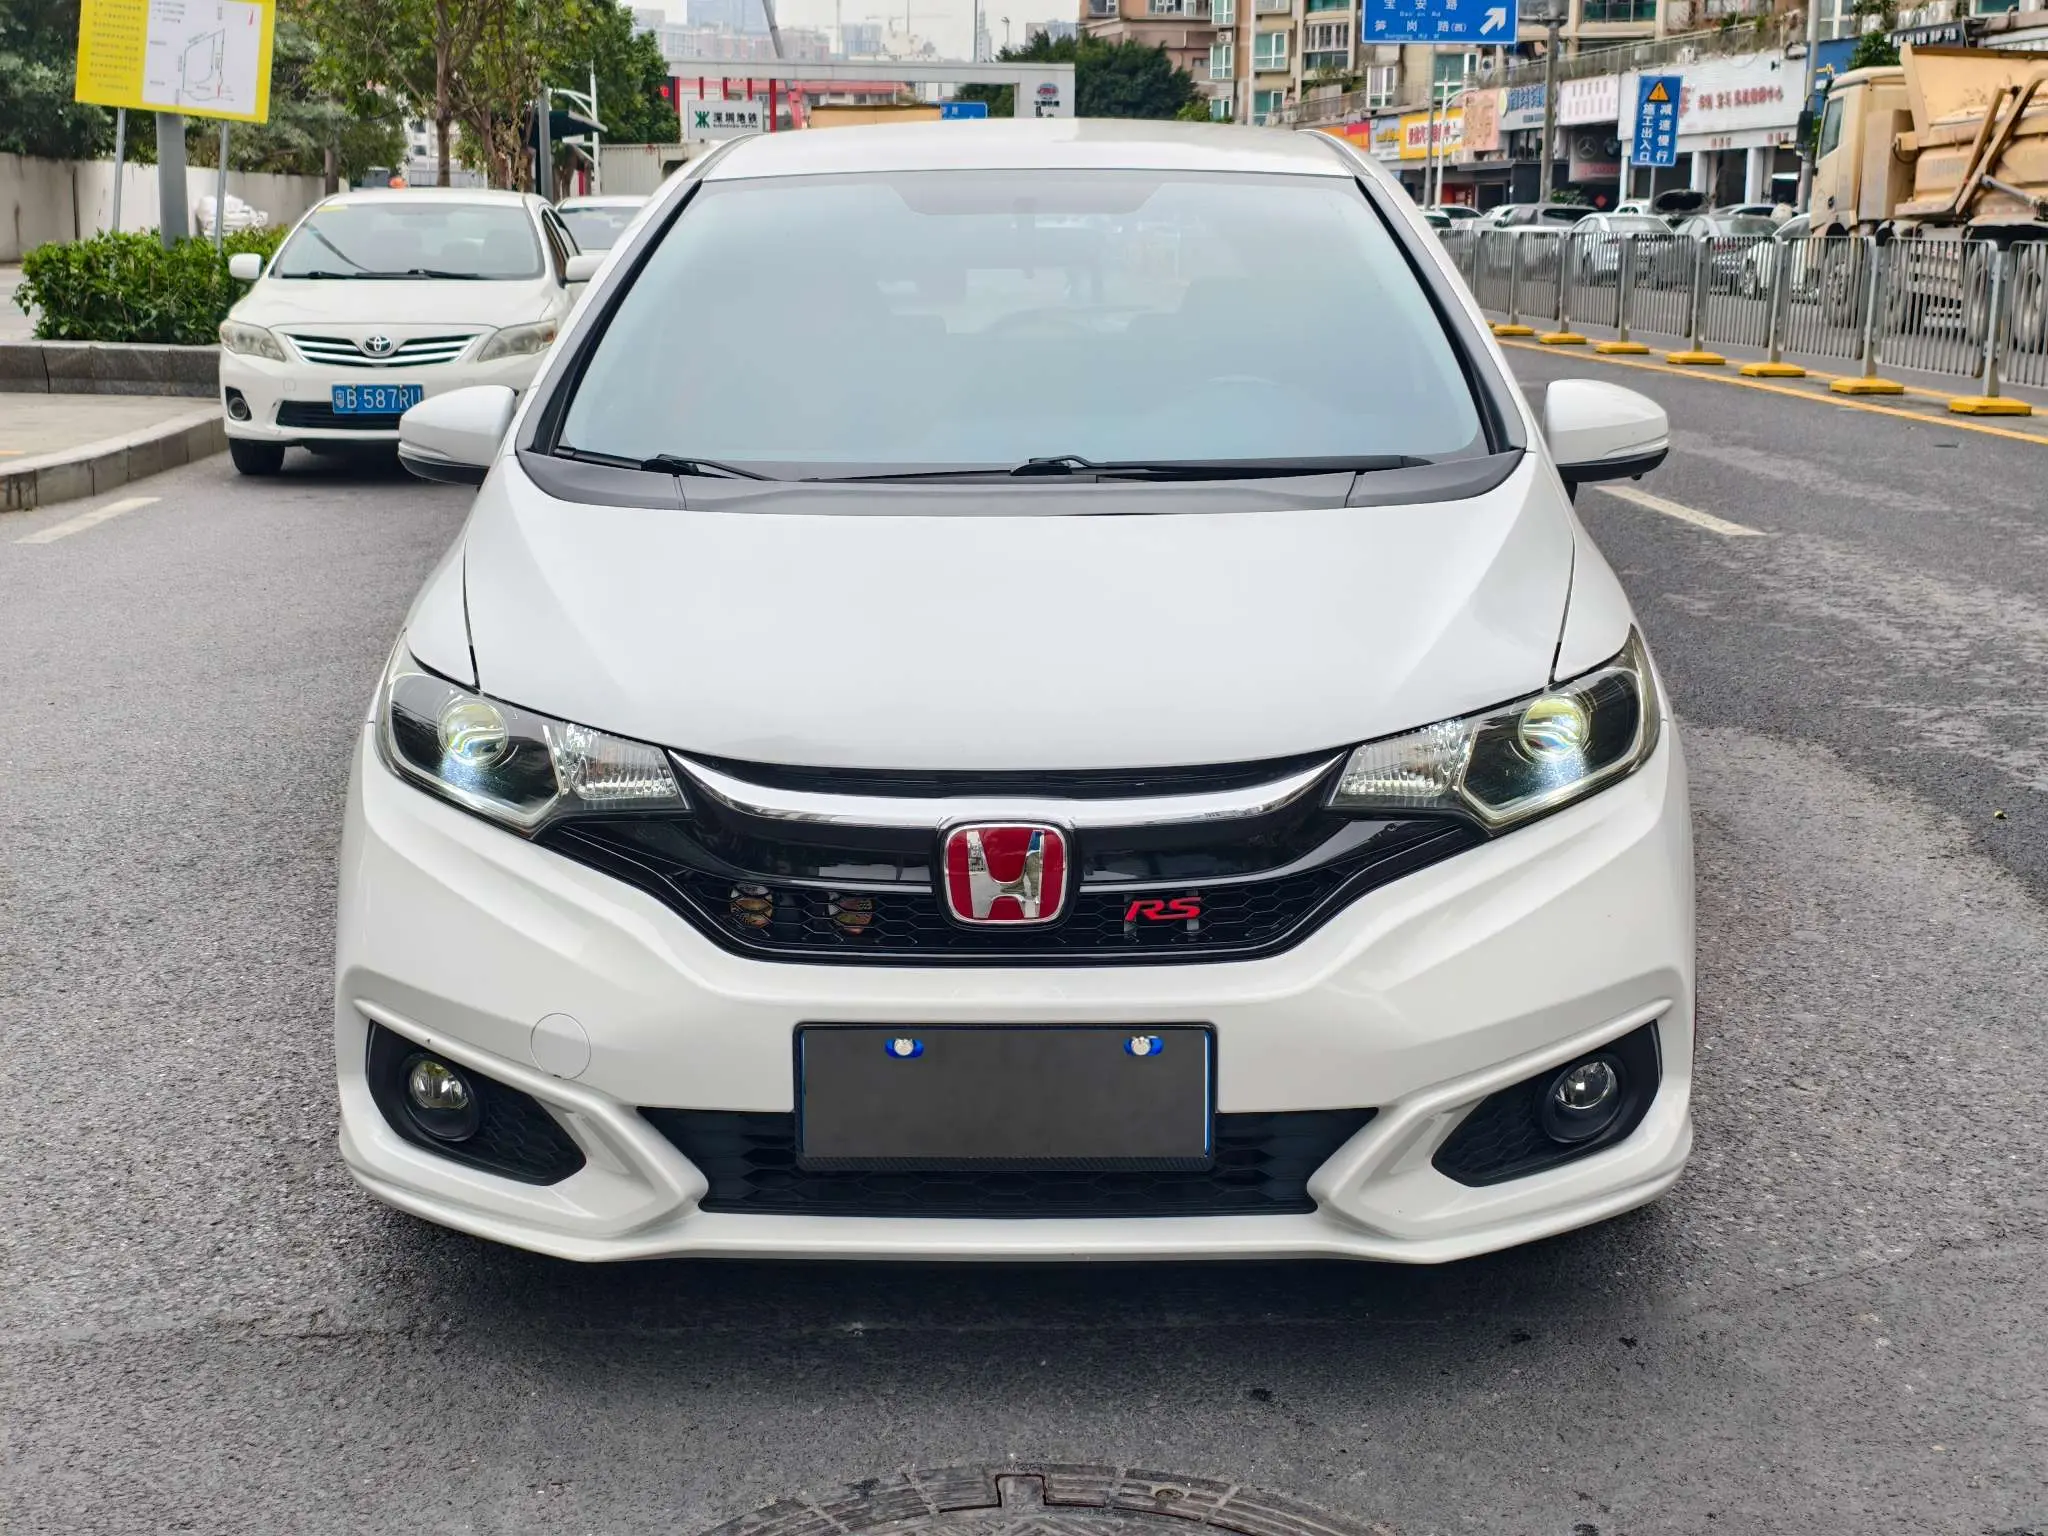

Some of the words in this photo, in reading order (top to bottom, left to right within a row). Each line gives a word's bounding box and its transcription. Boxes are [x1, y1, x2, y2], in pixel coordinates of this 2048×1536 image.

[713, 111, 758, 124] 深圳地铁
[1639, 103, 1655, 161] 施工出入口
[1125, 896, 1201, 922] RS
